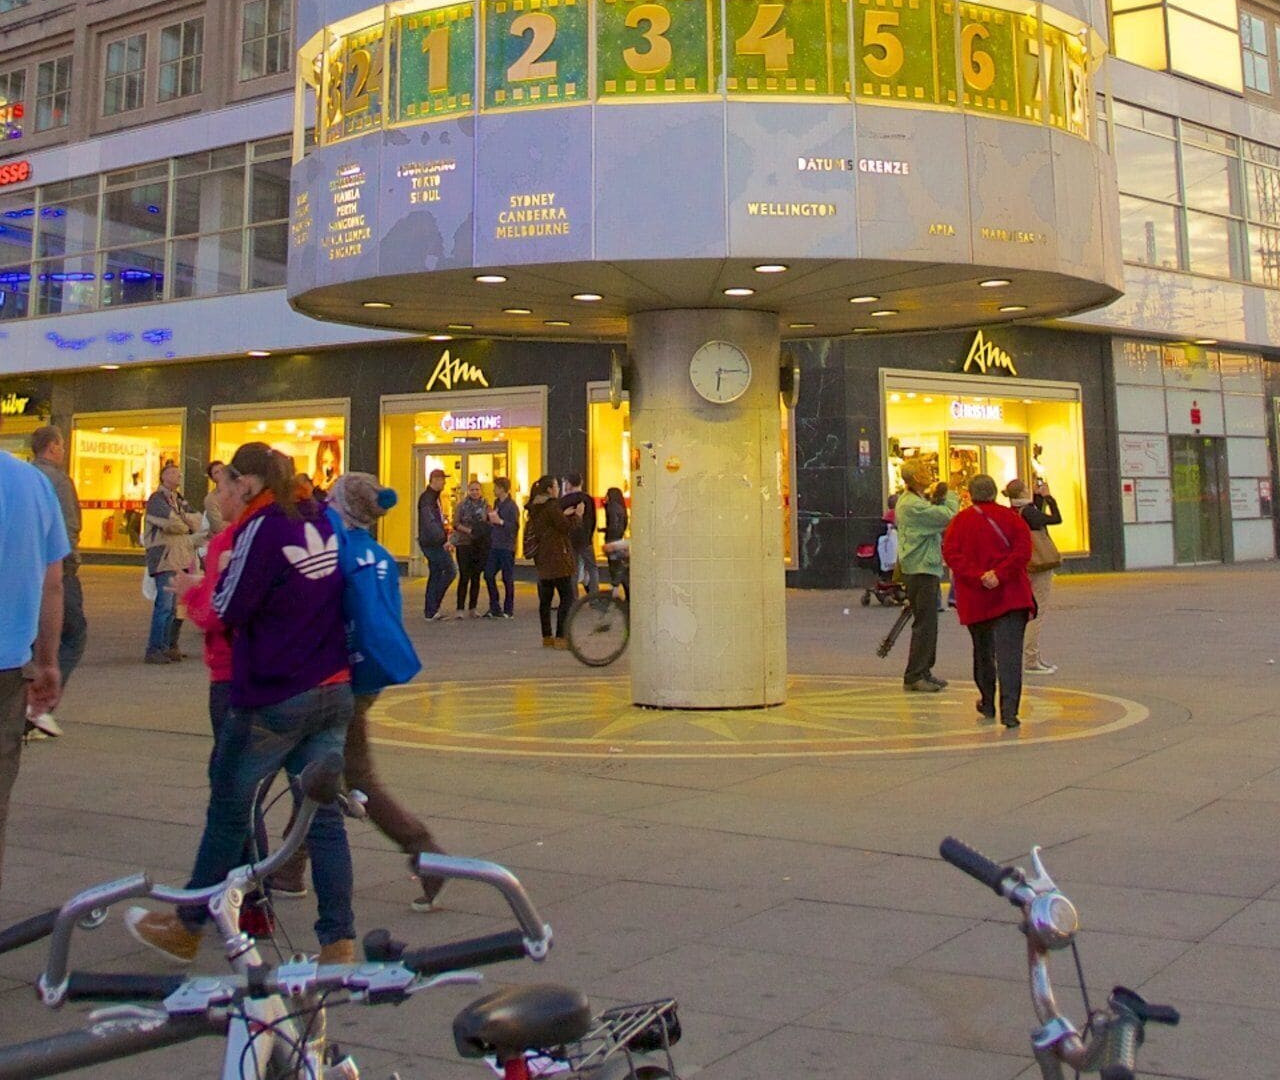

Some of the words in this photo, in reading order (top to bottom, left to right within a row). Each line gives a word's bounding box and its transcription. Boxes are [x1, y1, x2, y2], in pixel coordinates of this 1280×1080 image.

[422, 26, 450, 94] 1
[507, 12, 558, 83] 2
[623, 3, 673, 75] 3
[735, 3, 795, 72] 4
[862, 10, 905, 79] 5
[961, 22, 996, 92] 6
[1028, 38, 1053, 102] 7
[859, 158, 909, 175] GRENZE
[496, 222, 569, 238] MELBOURNE
[499, 207, 567, 224] CANBERRA
[510, 192, 555, 208] SYDNEY
[747, 202, 837, 217] WELLINGTON
